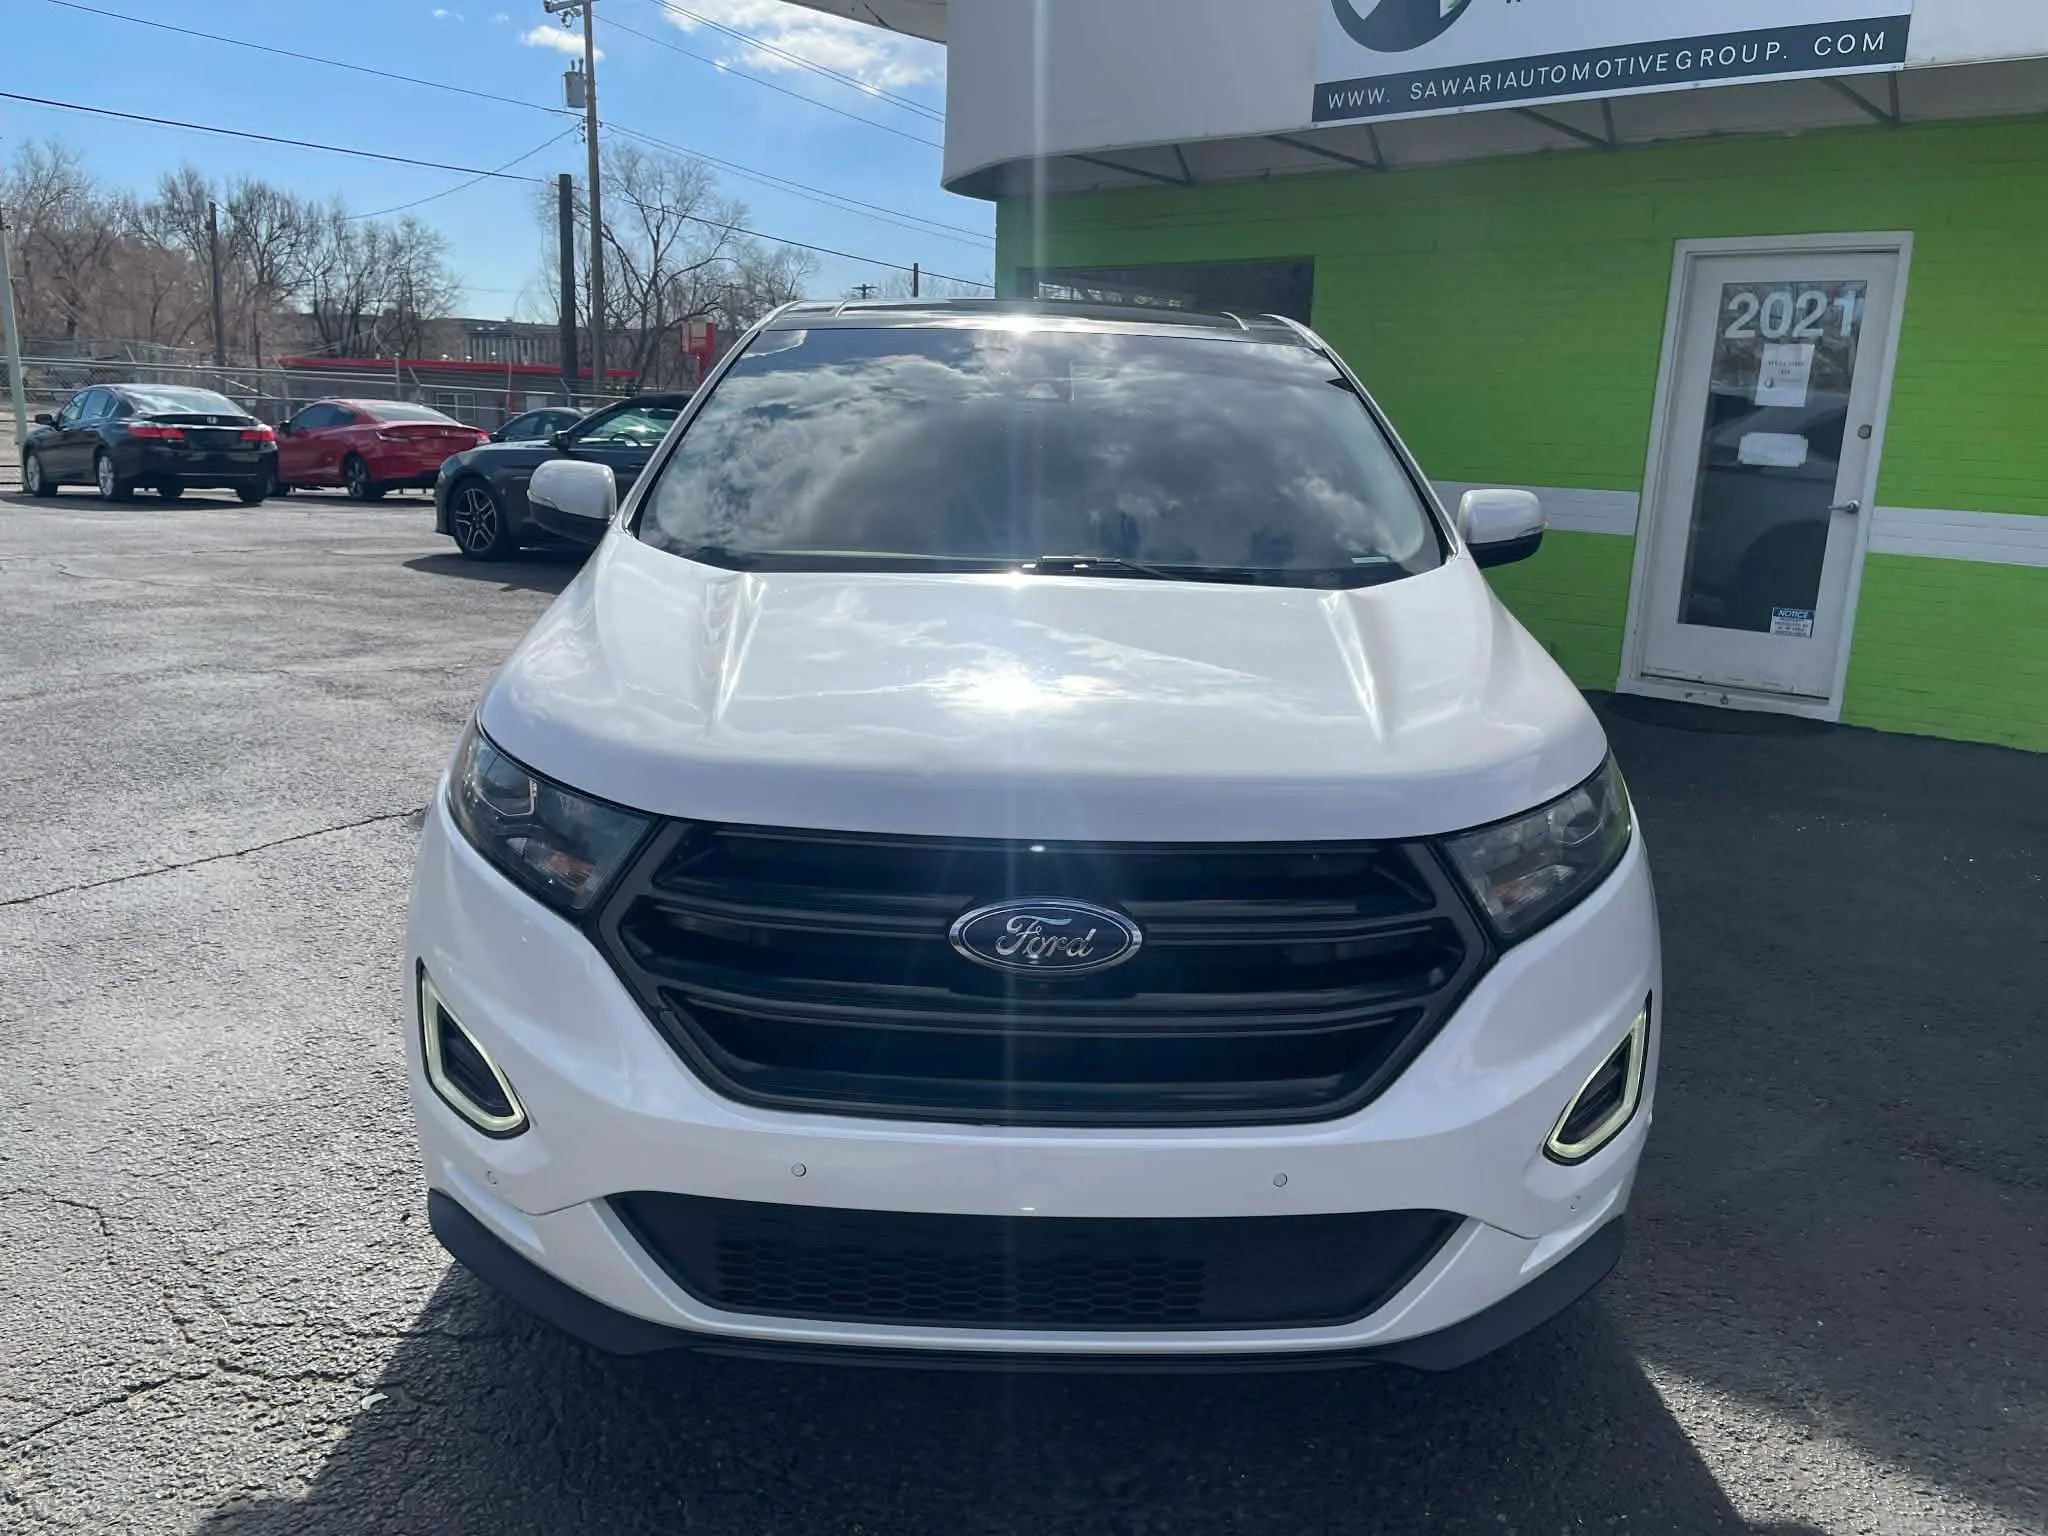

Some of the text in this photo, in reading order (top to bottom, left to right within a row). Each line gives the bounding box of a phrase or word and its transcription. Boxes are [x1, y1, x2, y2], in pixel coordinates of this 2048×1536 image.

[1328, 88, 1391, 110] WWW.
[1814, 31, 1885, 56] COM
[1724, 290, 1857, 339] 2021
[1778, 610, 1808, 619] NOTICE
[995, 915, 1097, 958] Ford
